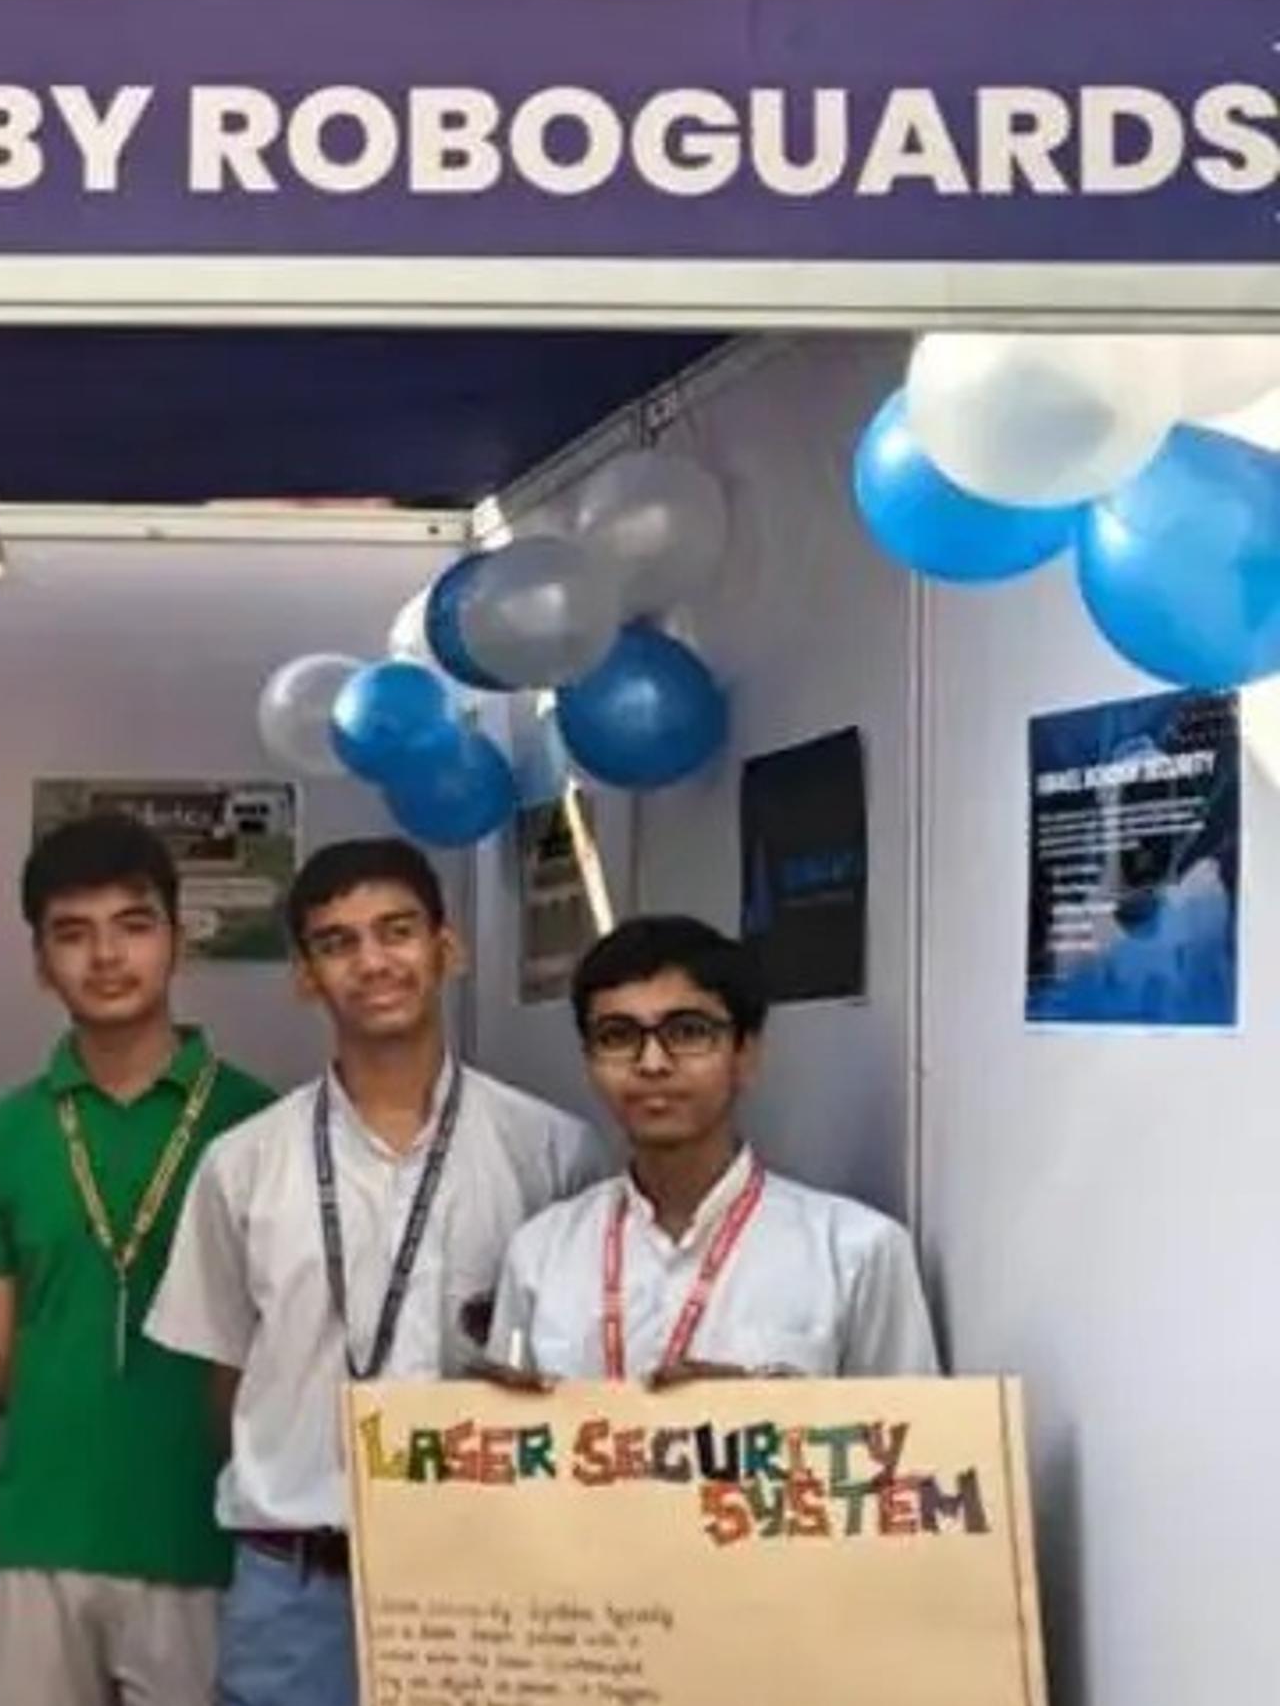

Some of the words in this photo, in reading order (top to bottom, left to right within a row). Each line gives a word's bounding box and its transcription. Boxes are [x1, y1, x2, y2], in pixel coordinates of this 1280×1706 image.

[188, 85, 1280, 197] ROBOGUARDS
[360, 1411, 556, 1483] LASER
[573, 1417, 909, 1488] SECURITY
[701, 1467, 989, 1546] SYSTEM
